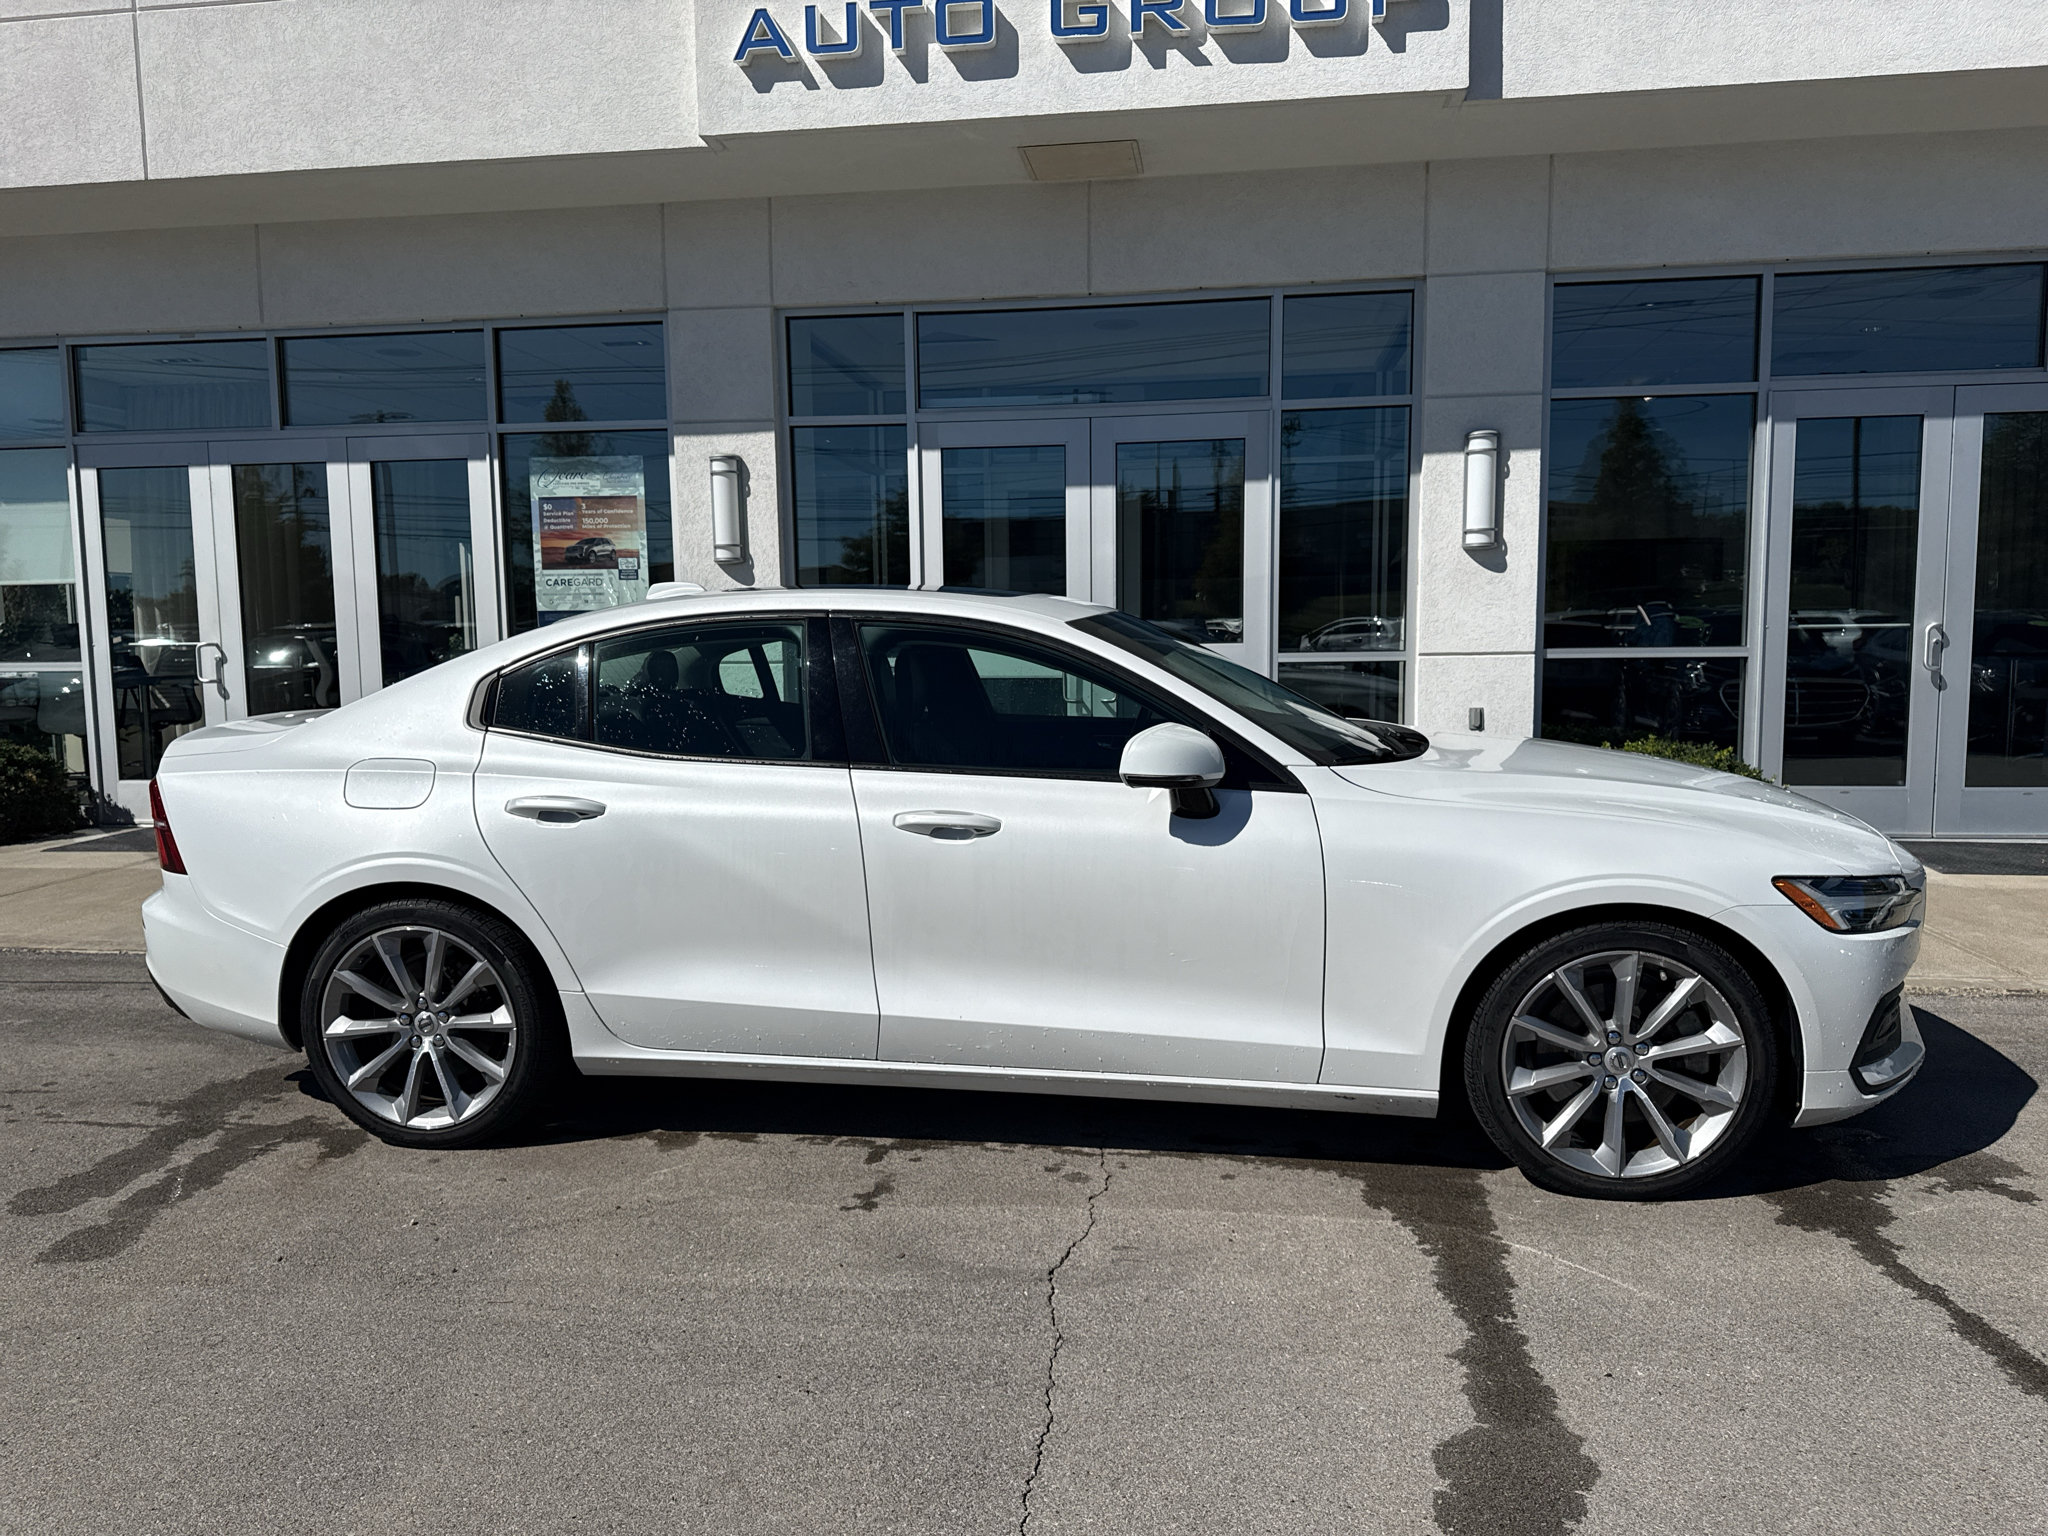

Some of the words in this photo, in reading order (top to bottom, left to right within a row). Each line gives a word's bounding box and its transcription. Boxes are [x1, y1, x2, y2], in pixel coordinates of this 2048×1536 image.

[733, 0, 1000, 64] AUTO
[542, 503, 553, 511] $0
[545, 578, 603, 587] CAREGARD
